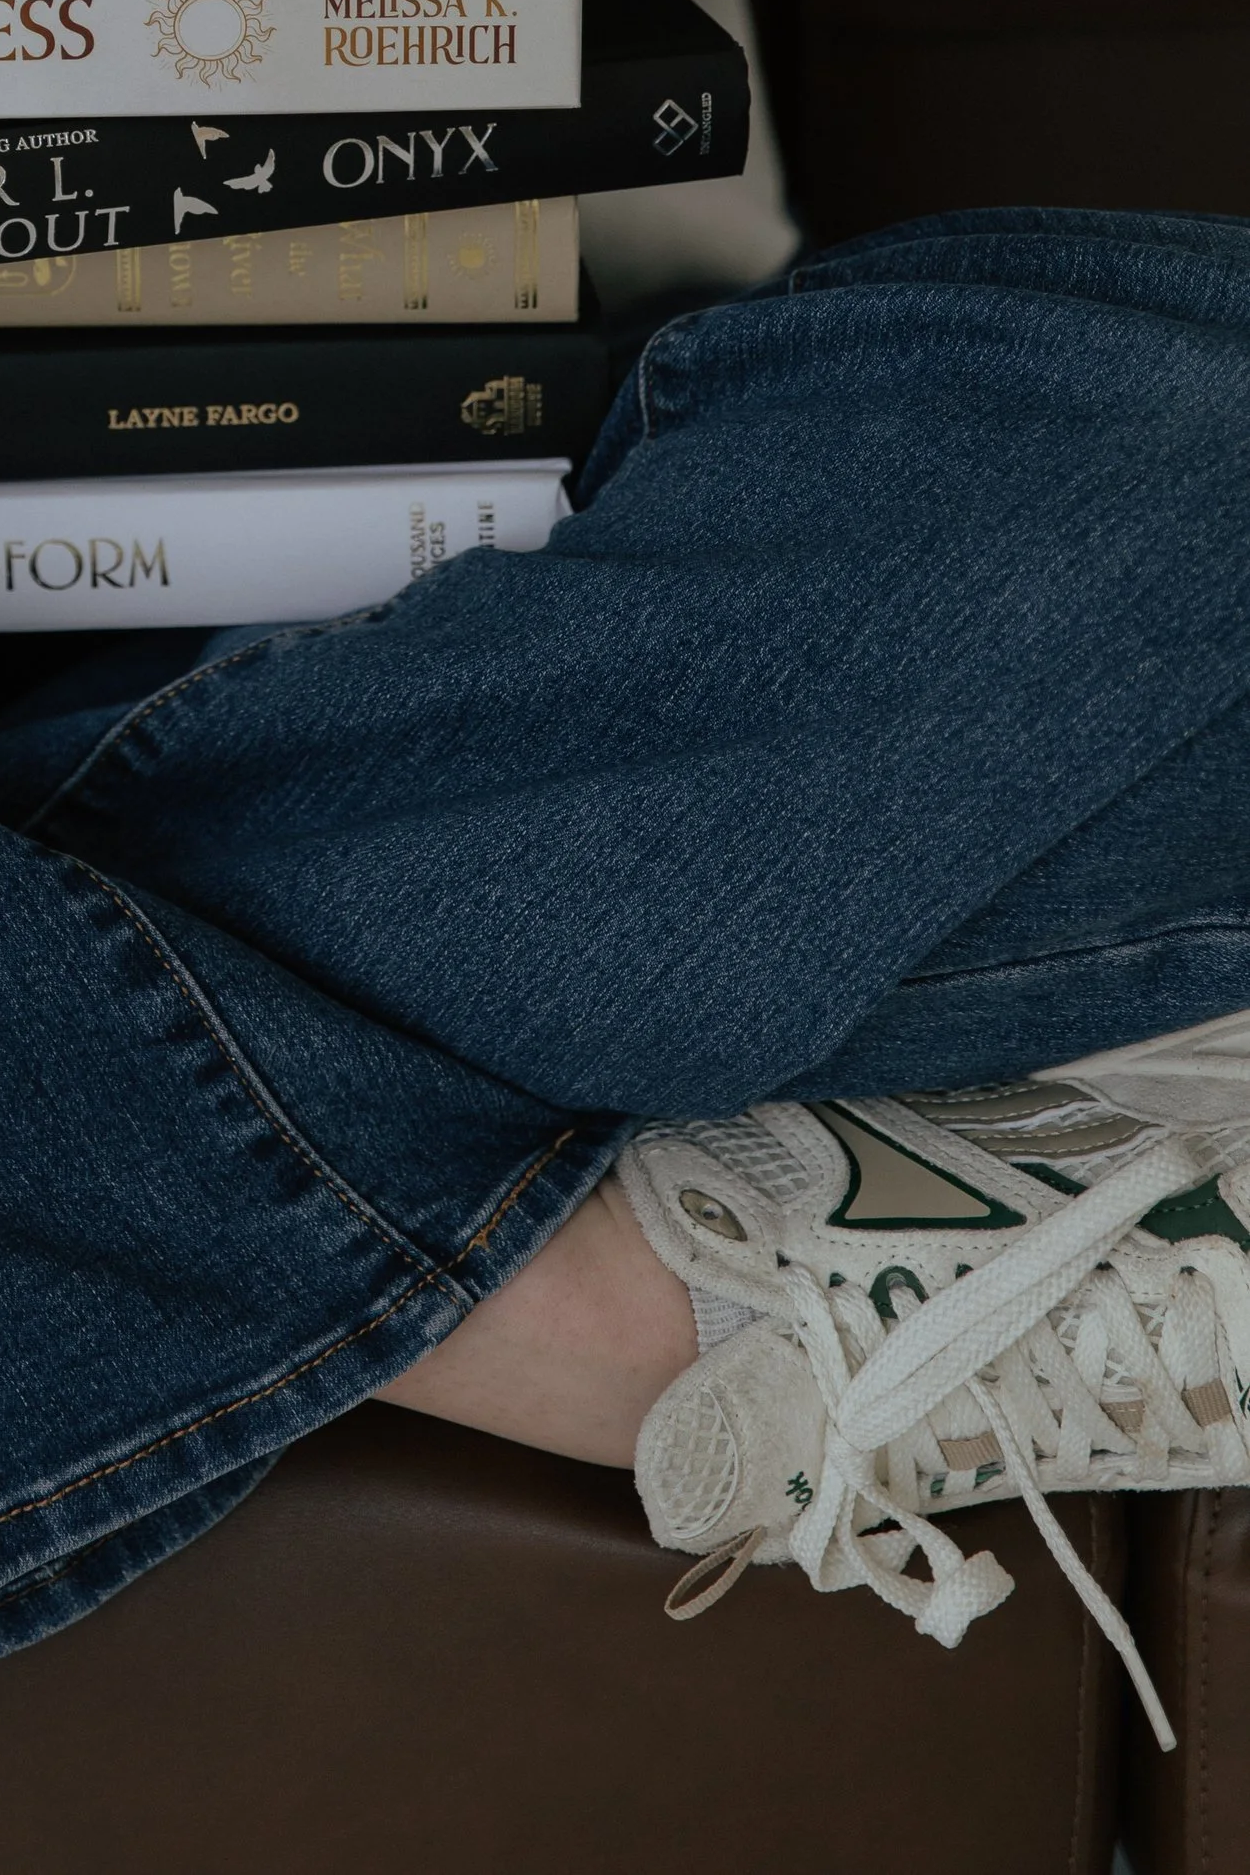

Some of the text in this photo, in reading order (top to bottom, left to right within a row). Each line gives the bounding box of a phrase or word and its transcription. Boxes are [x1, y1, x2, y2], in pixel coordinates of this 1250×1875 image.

[324, 24, 518, 67] ROEHRICH
[15, 128, 100, 151] AUTHOR
[322, 122, 499, 189] ONYX
[50, 155, 96, 203] L.
[108, 402, 300, 430] LAYNE FARGO
